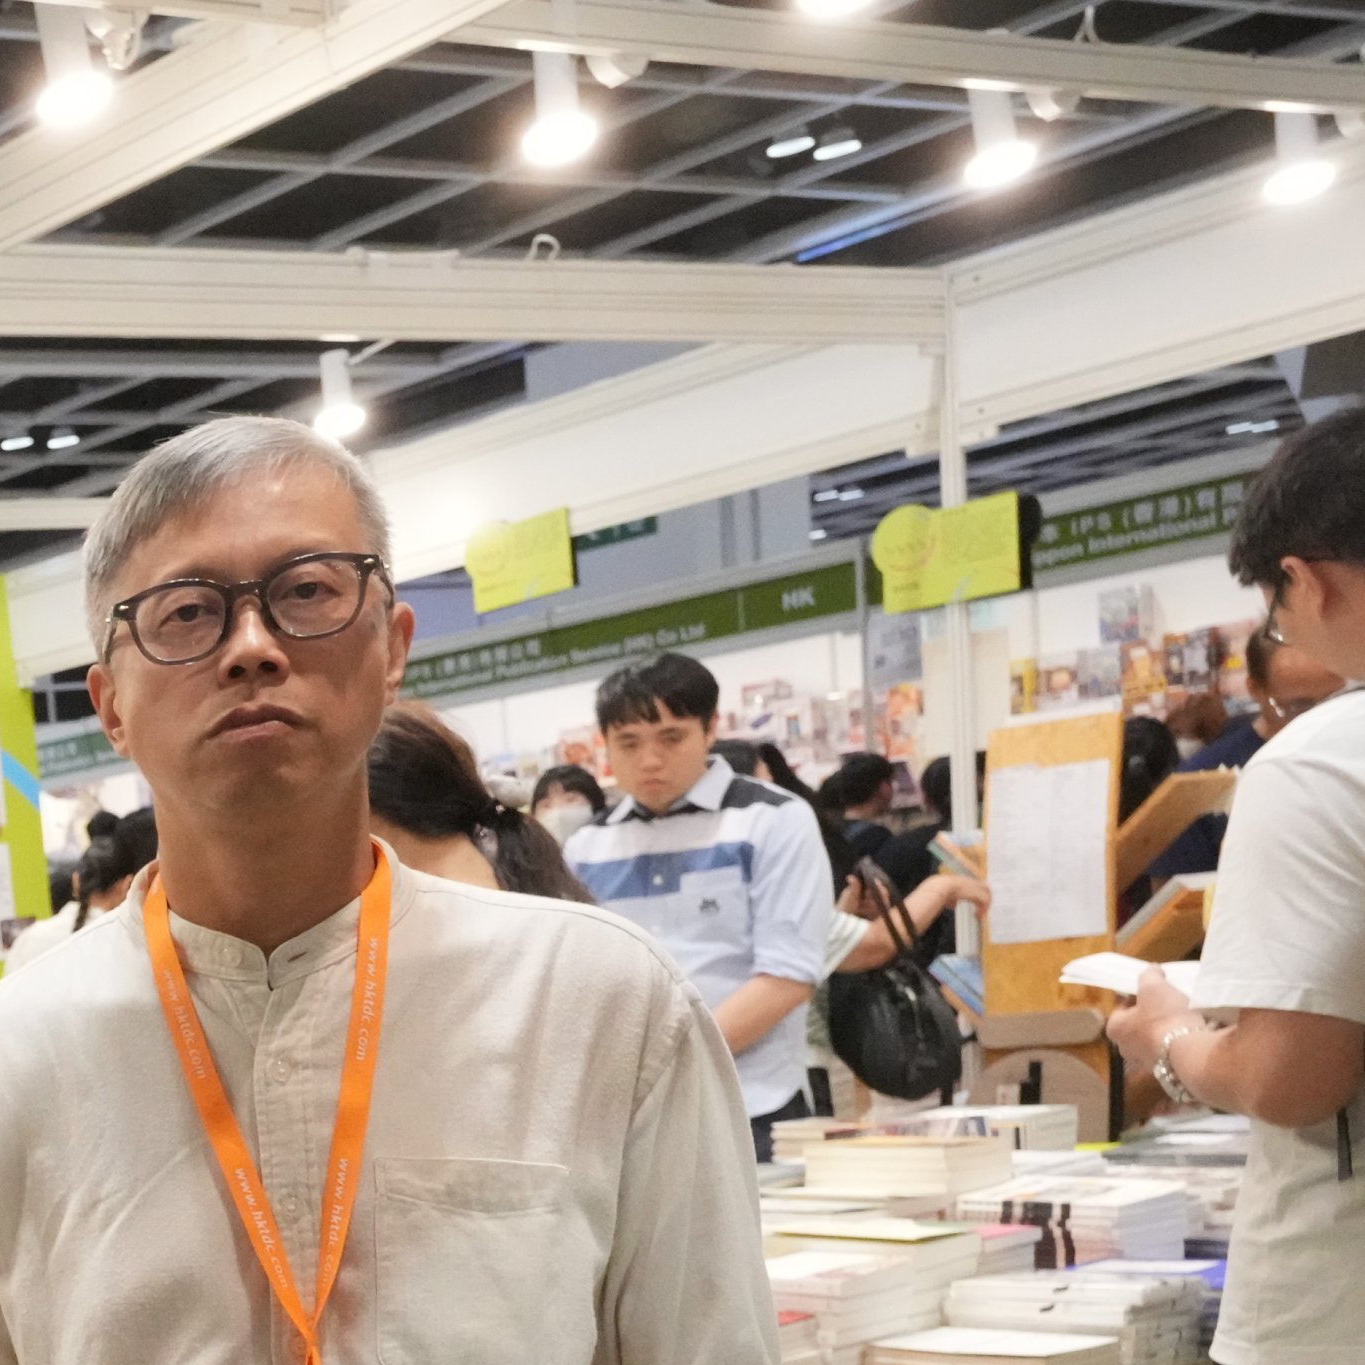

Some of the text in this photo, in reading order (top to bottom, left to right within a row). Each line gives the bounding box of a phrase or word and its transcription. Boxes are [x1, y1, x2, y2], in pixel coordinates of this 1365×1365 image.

[164, 967, 207, 1080] www.hktdc.com
[356, 937, 378, 1061] www.hktdc.com
[235, 1167, 288, 1288] www.hktdc.com
